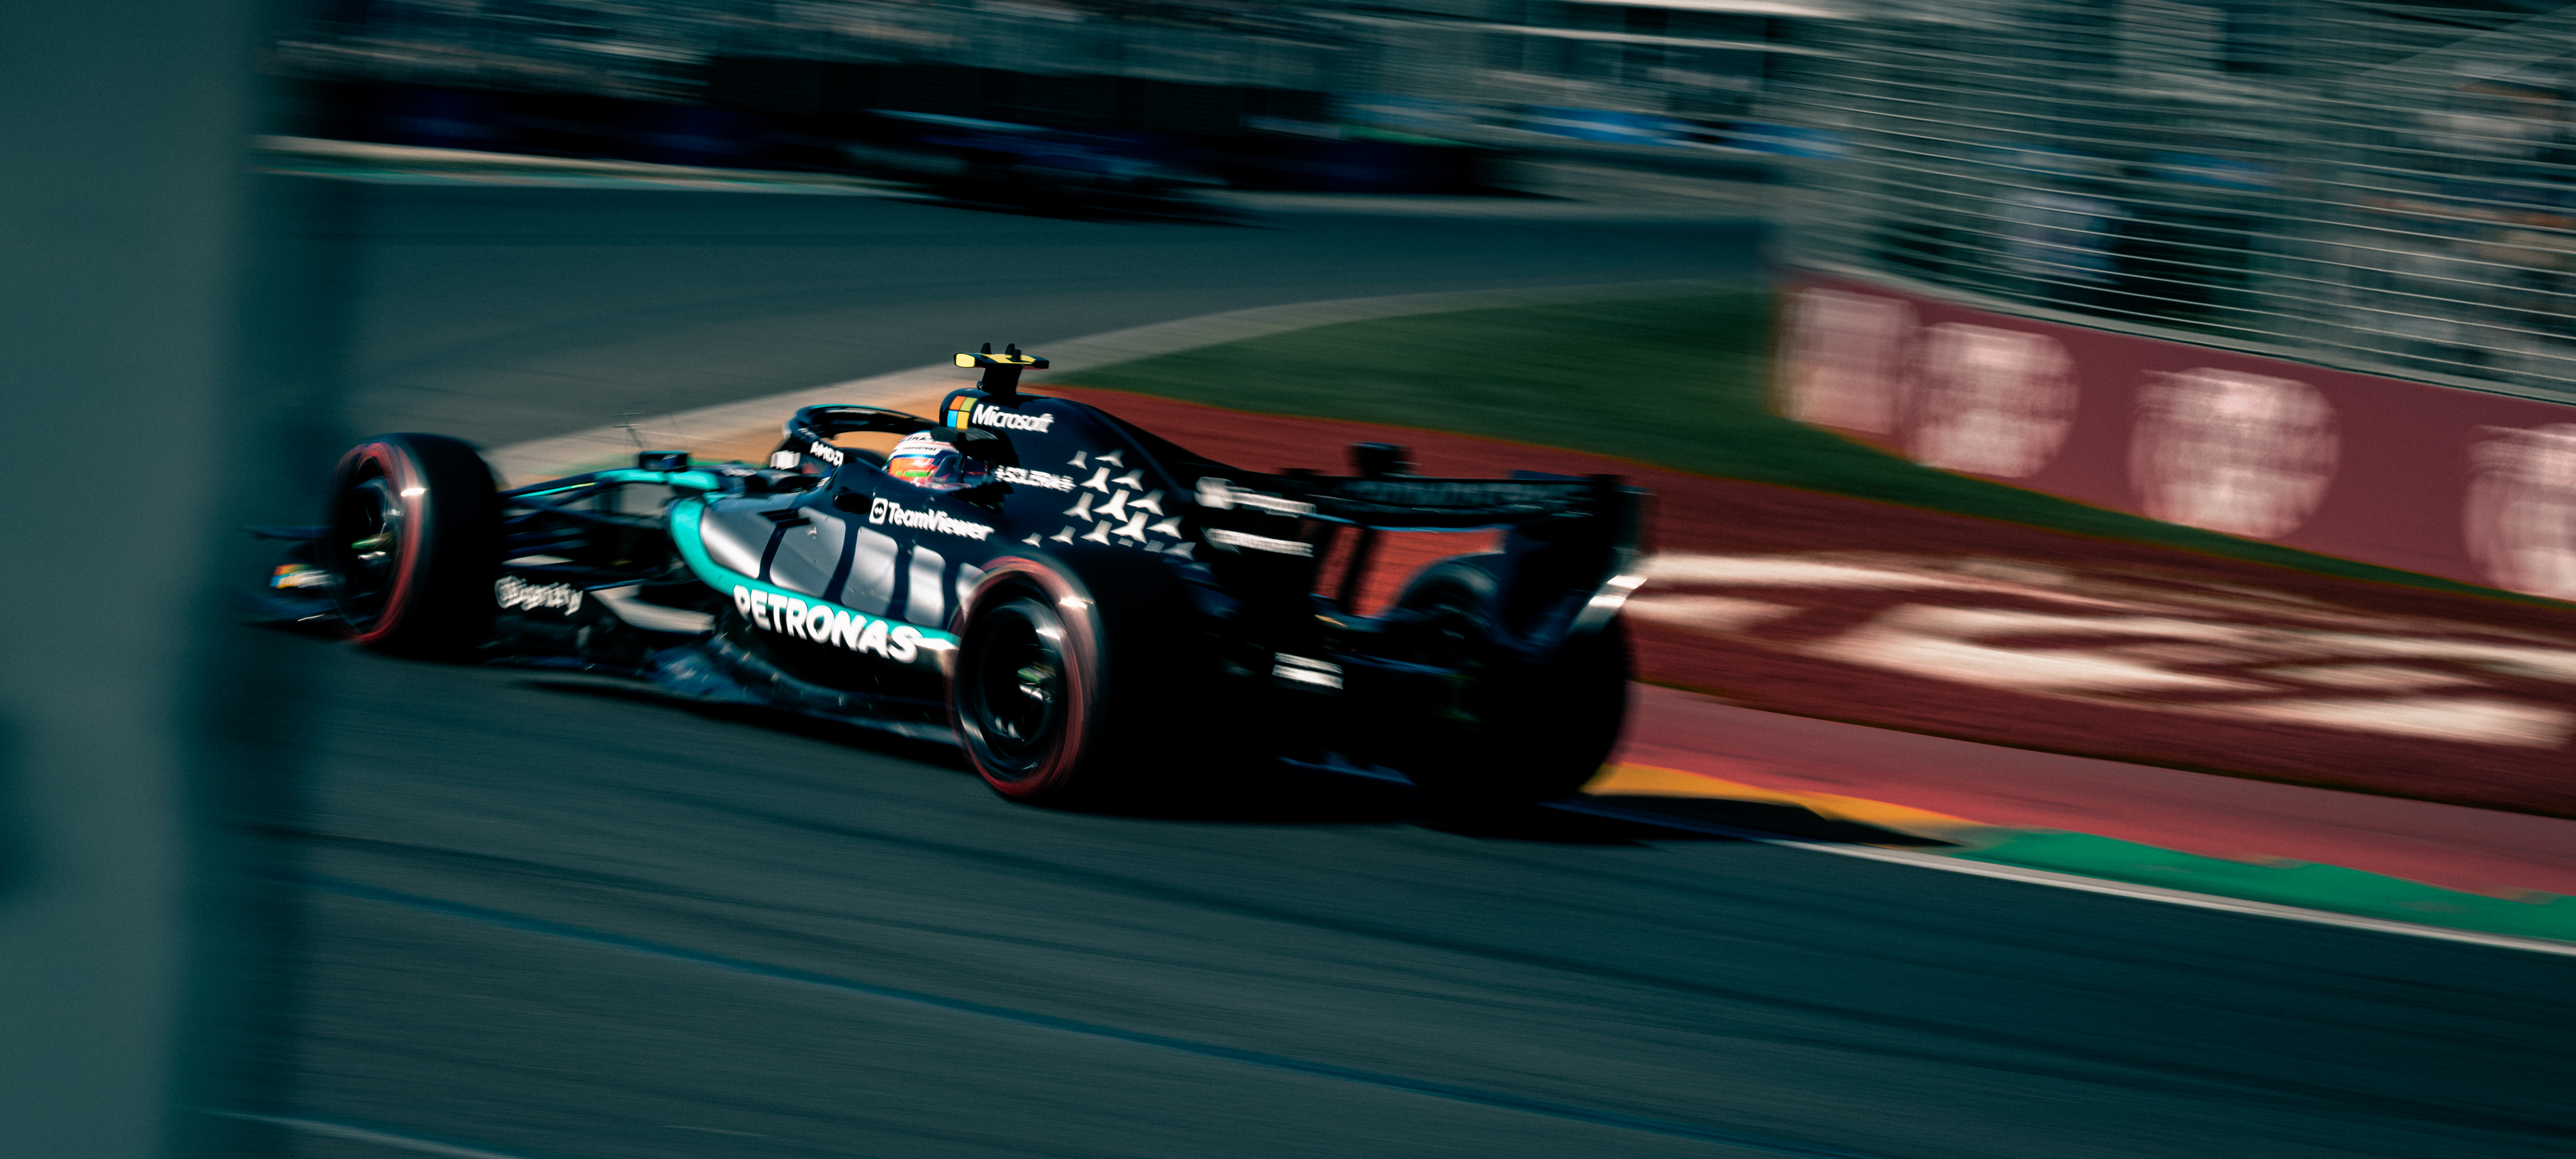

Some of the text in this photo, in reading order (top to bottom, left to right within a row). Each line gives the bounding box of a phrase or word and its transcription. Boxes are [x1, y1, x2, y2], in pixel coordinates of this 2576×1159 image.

[972, 404, 1054, 433] Microsoft
[889, 502, 995, 541] TeamViewer
[733, 584, 923, 664] PETRONAS
